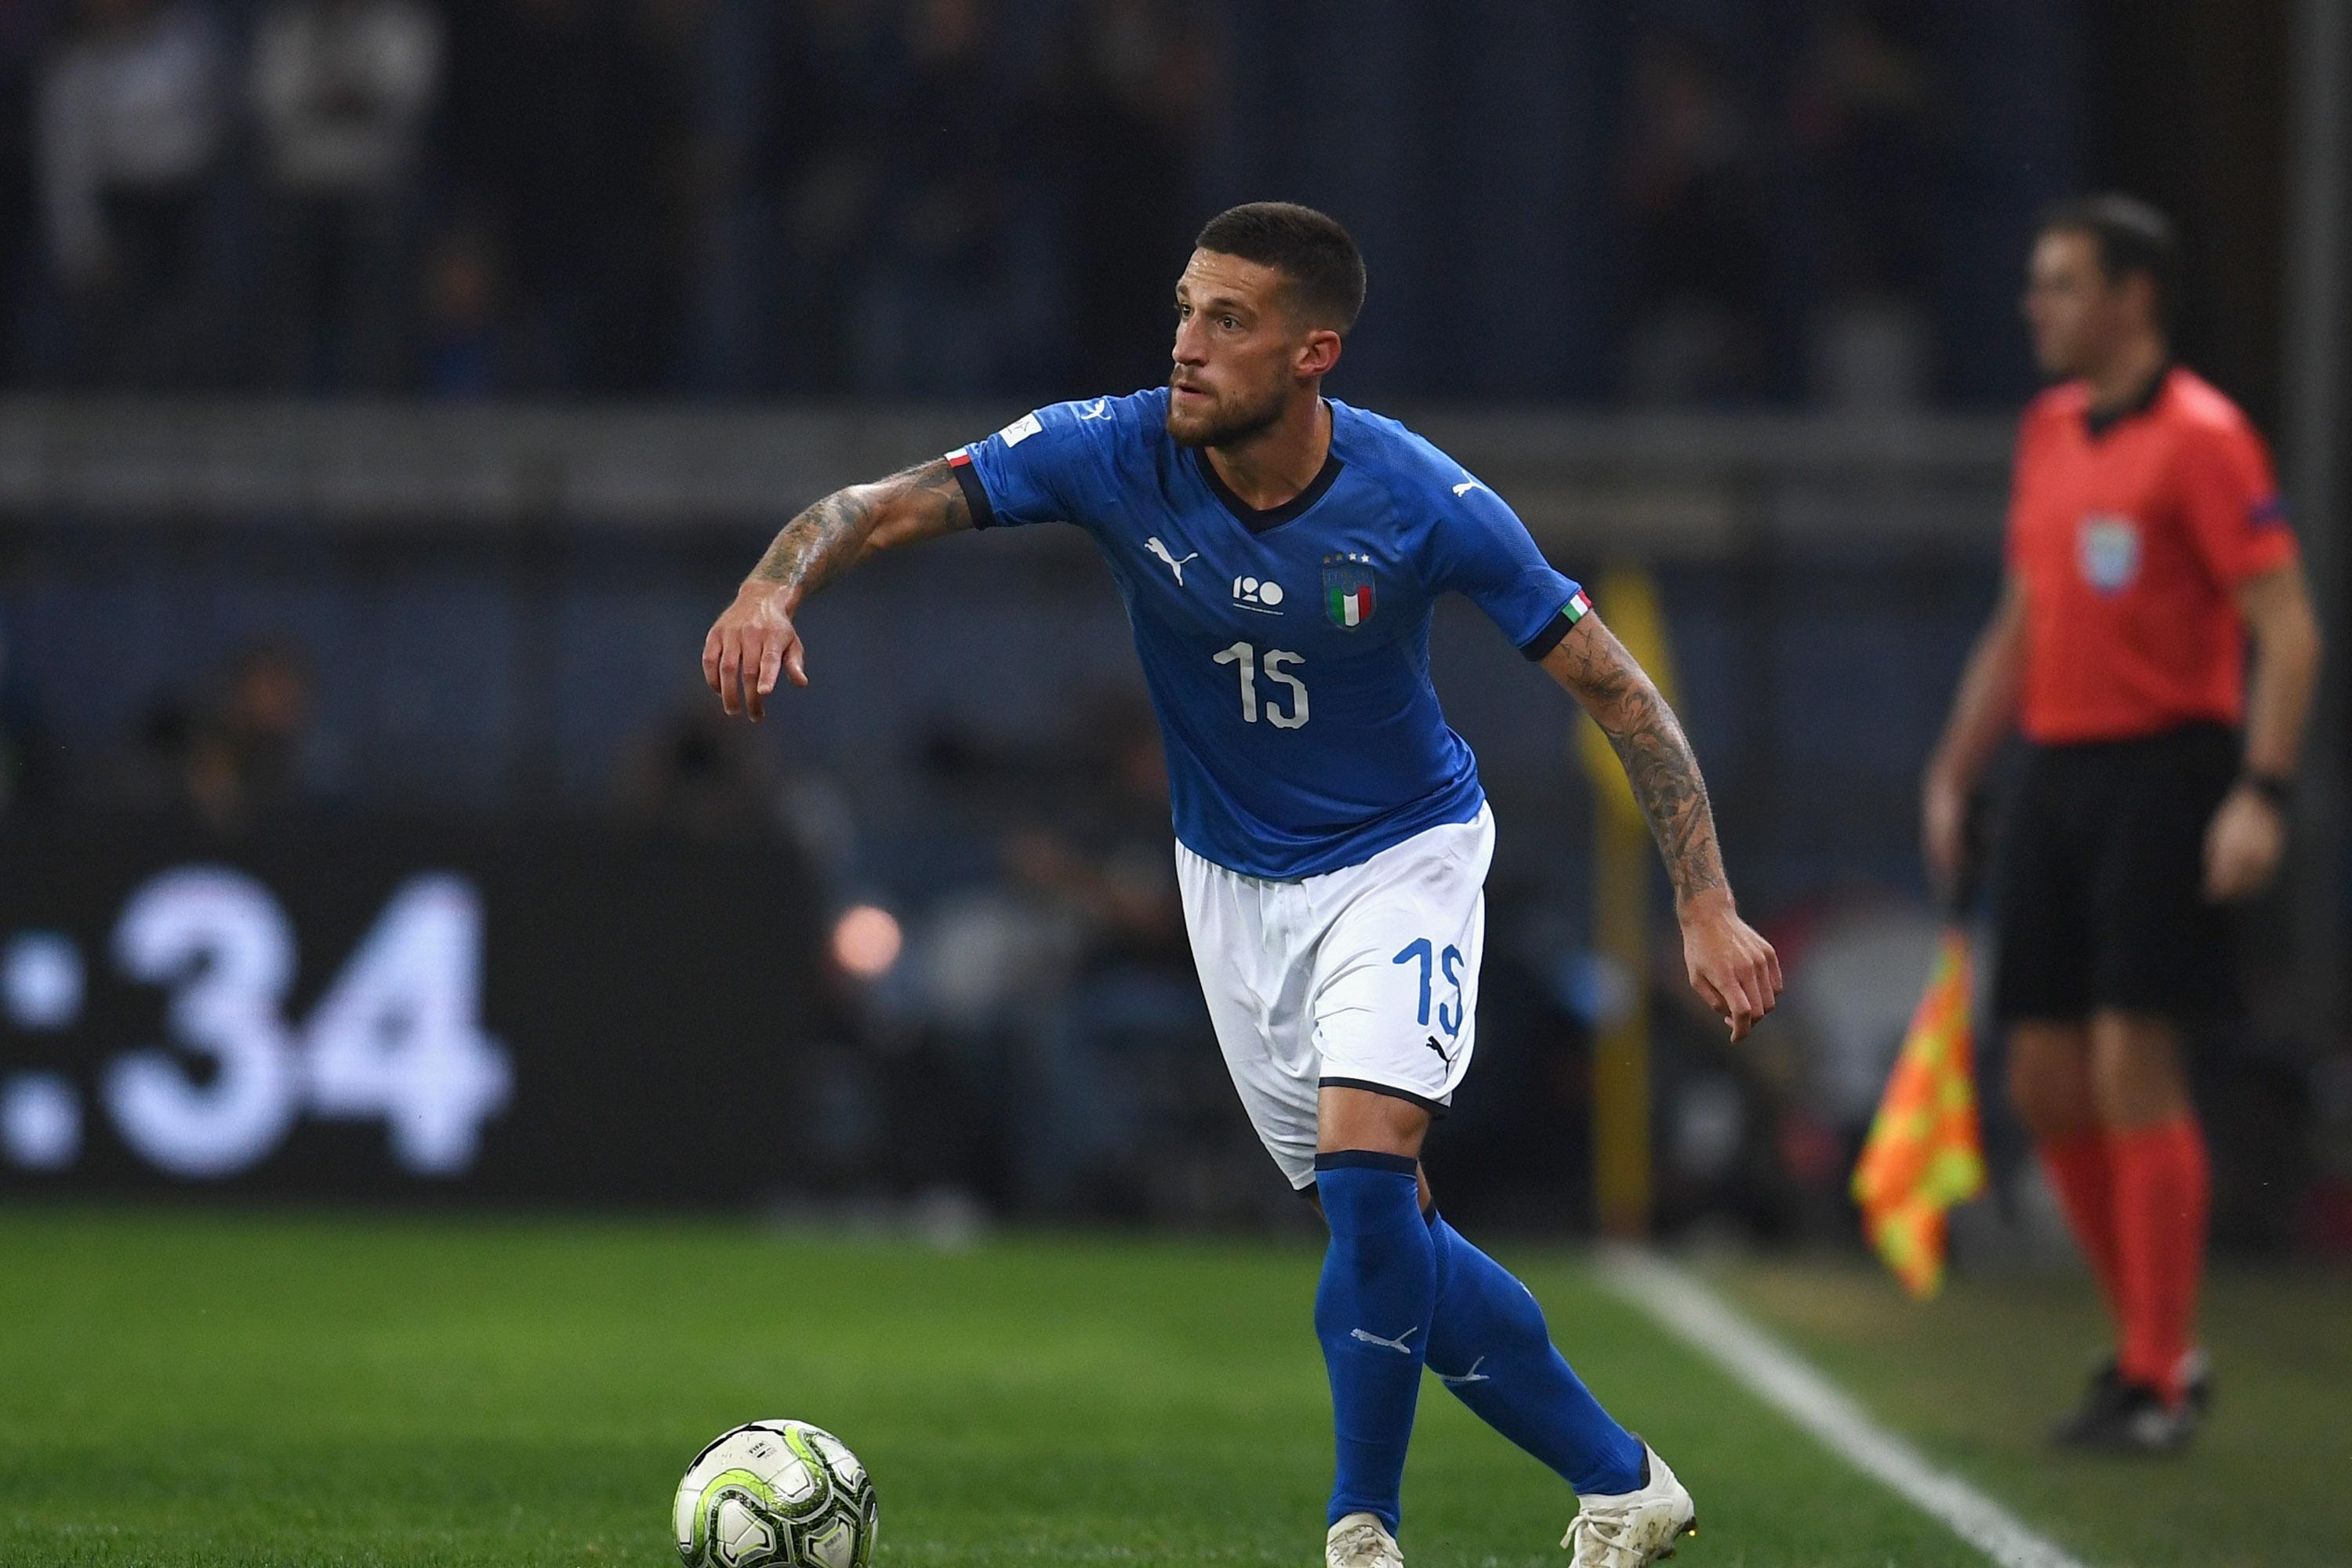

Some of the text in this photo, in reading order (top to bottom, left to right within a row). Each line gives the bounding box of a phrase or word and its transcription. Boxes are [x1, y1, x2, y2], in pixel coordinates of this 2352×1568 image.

[1232, 575, 1283, 605] 120
[1213, 641, 1309, 729] 15
[1392, 938, 1465, 1040] 15
